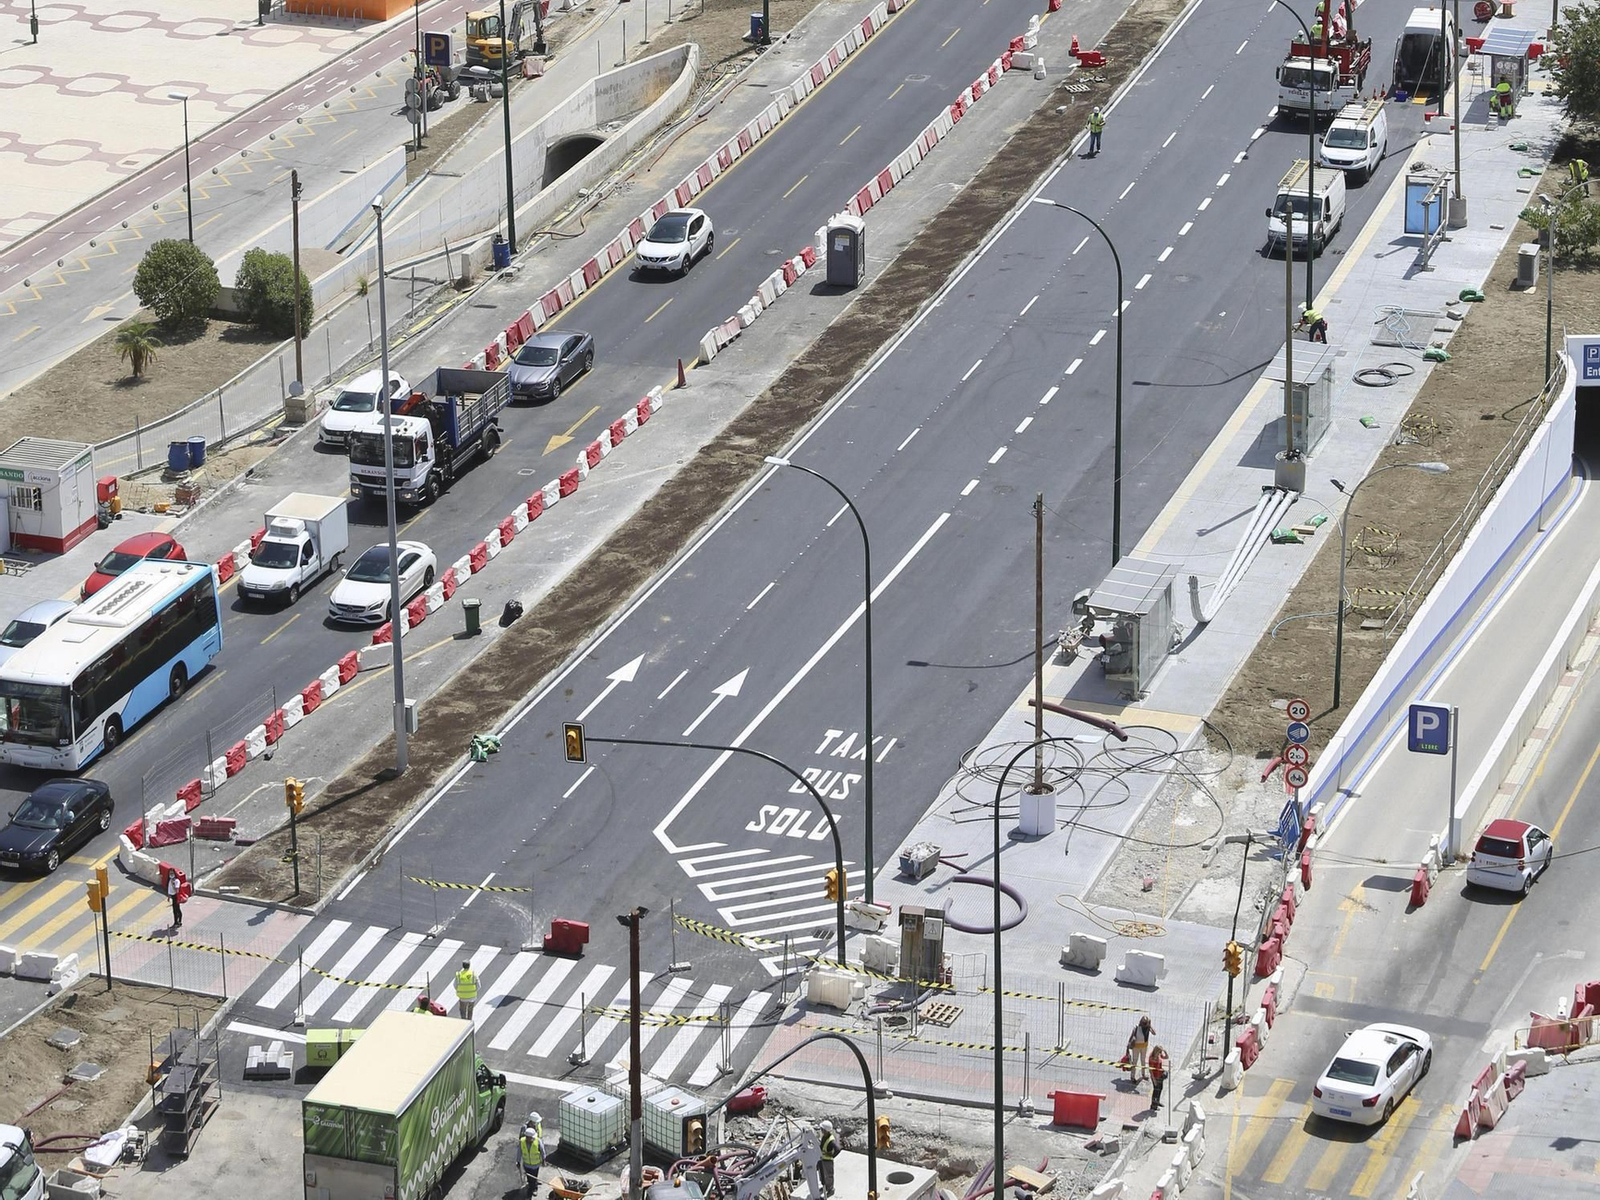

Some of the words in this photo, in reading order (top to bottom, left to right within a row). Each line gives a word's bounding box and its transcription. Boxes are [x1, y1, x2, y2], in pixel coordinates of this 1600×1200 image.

[430, 36, 446, 57] P
[1589, 348, 1598, 358] P
[1291, 706, 1306, 715] 20
[1416, 710, 1440, 740] P
[814, 729, 898, 763] TAXI
[1421, 743, 1439, 751] LIBRE
[788, 767, 862, 800] BUS
[744, 804, 842, 841] SOLO
